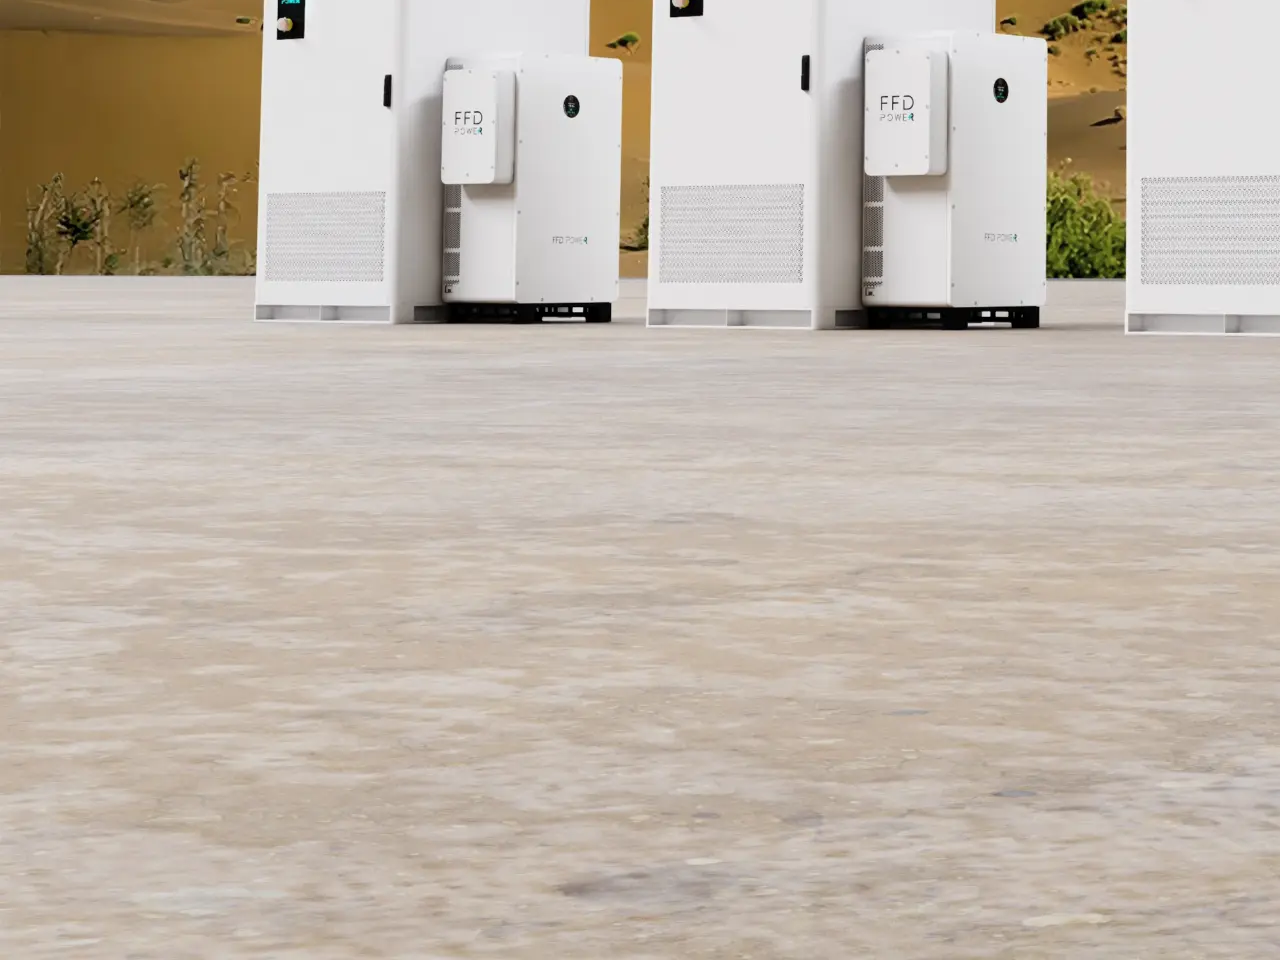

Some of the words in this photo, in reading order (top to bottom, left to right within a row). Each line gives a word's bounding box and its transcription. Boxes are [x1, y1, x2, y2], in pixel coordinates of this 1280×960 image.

[880, 94, 914, 111] FFD
[454, 110, 483, 126] FFD
[880, 112, 915, 122] POWER
[454, 126, 483, 136] POWER
